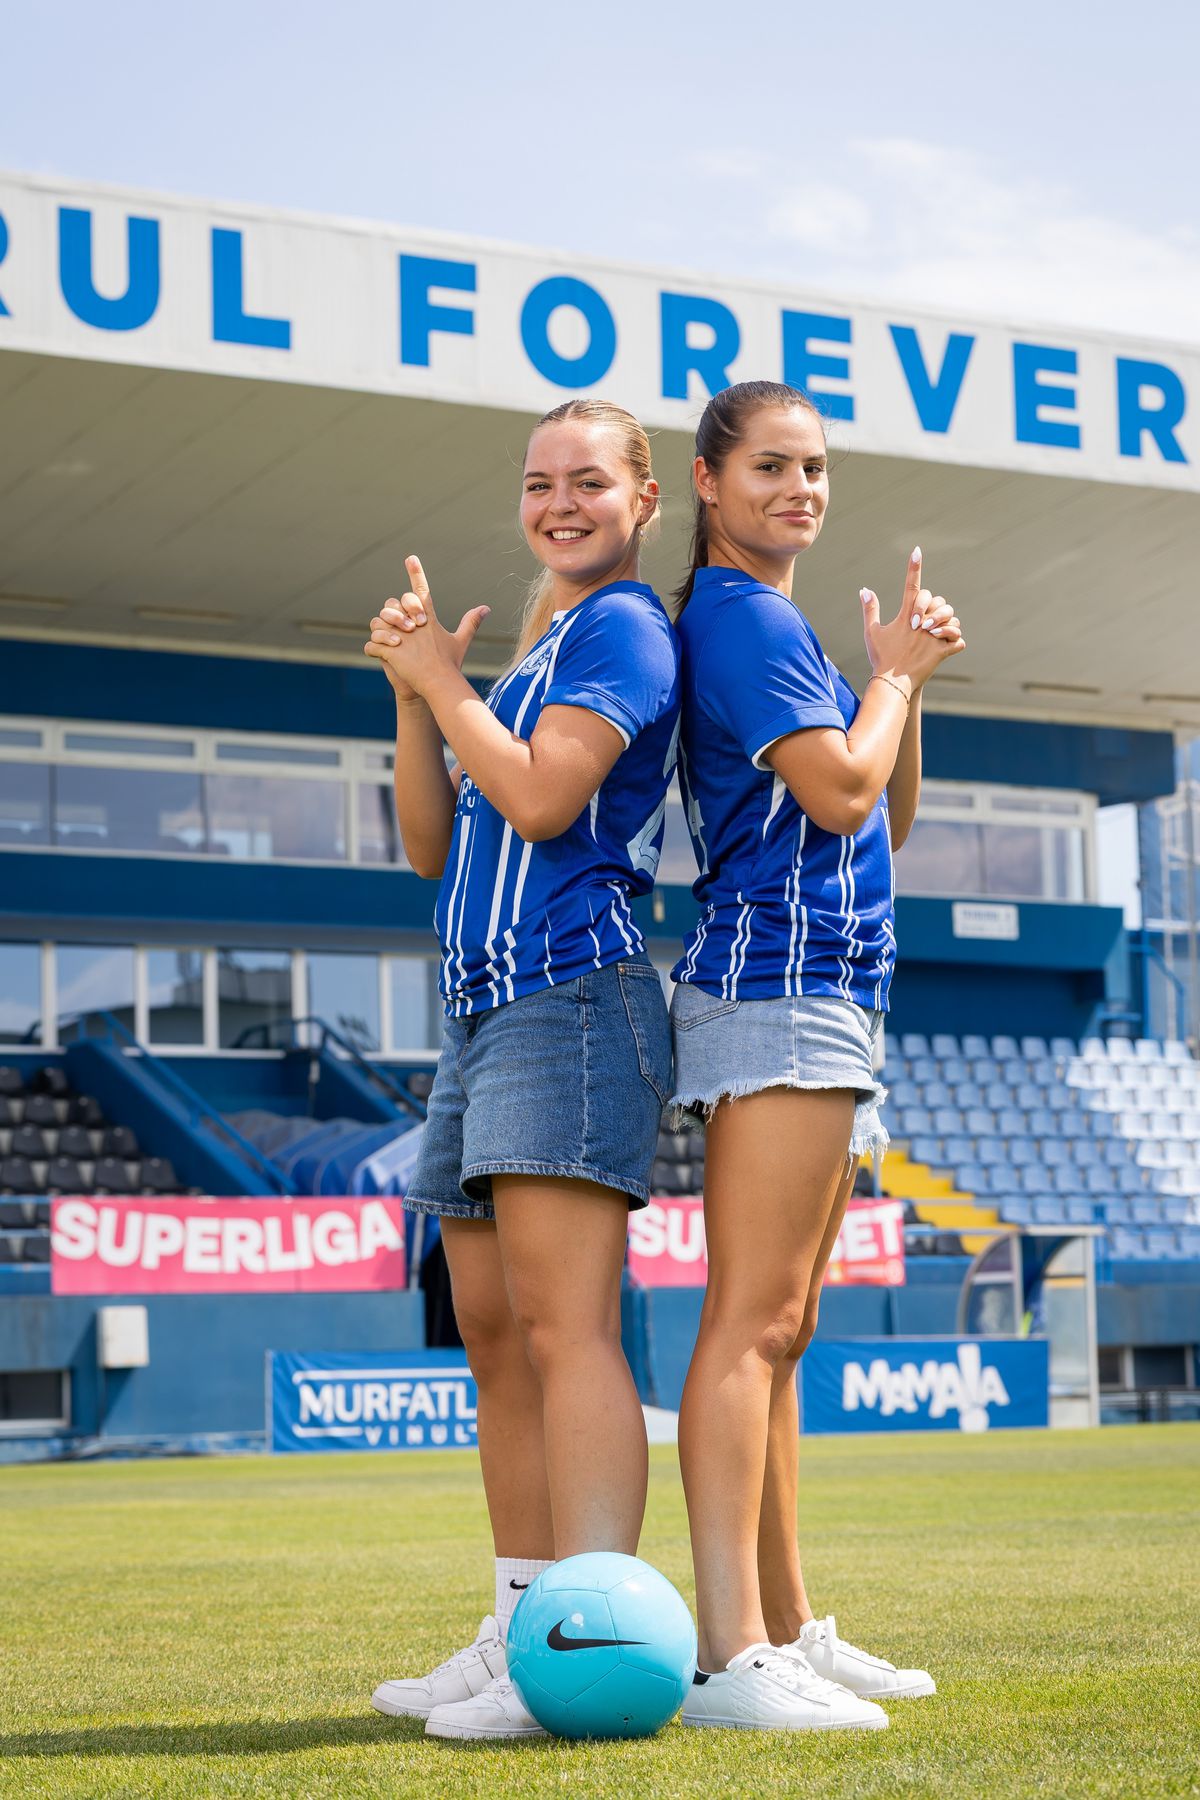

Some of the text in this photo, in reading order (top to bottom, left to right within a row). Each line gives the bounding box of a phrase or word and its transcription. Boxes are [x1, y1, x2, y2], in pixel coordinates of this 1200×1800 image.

[399, 253, 1187, 464] FOREVER
[52, 1202, 403, 1273] SUPERLIGA
[299, 1382, 477, 1423] MURFATL
